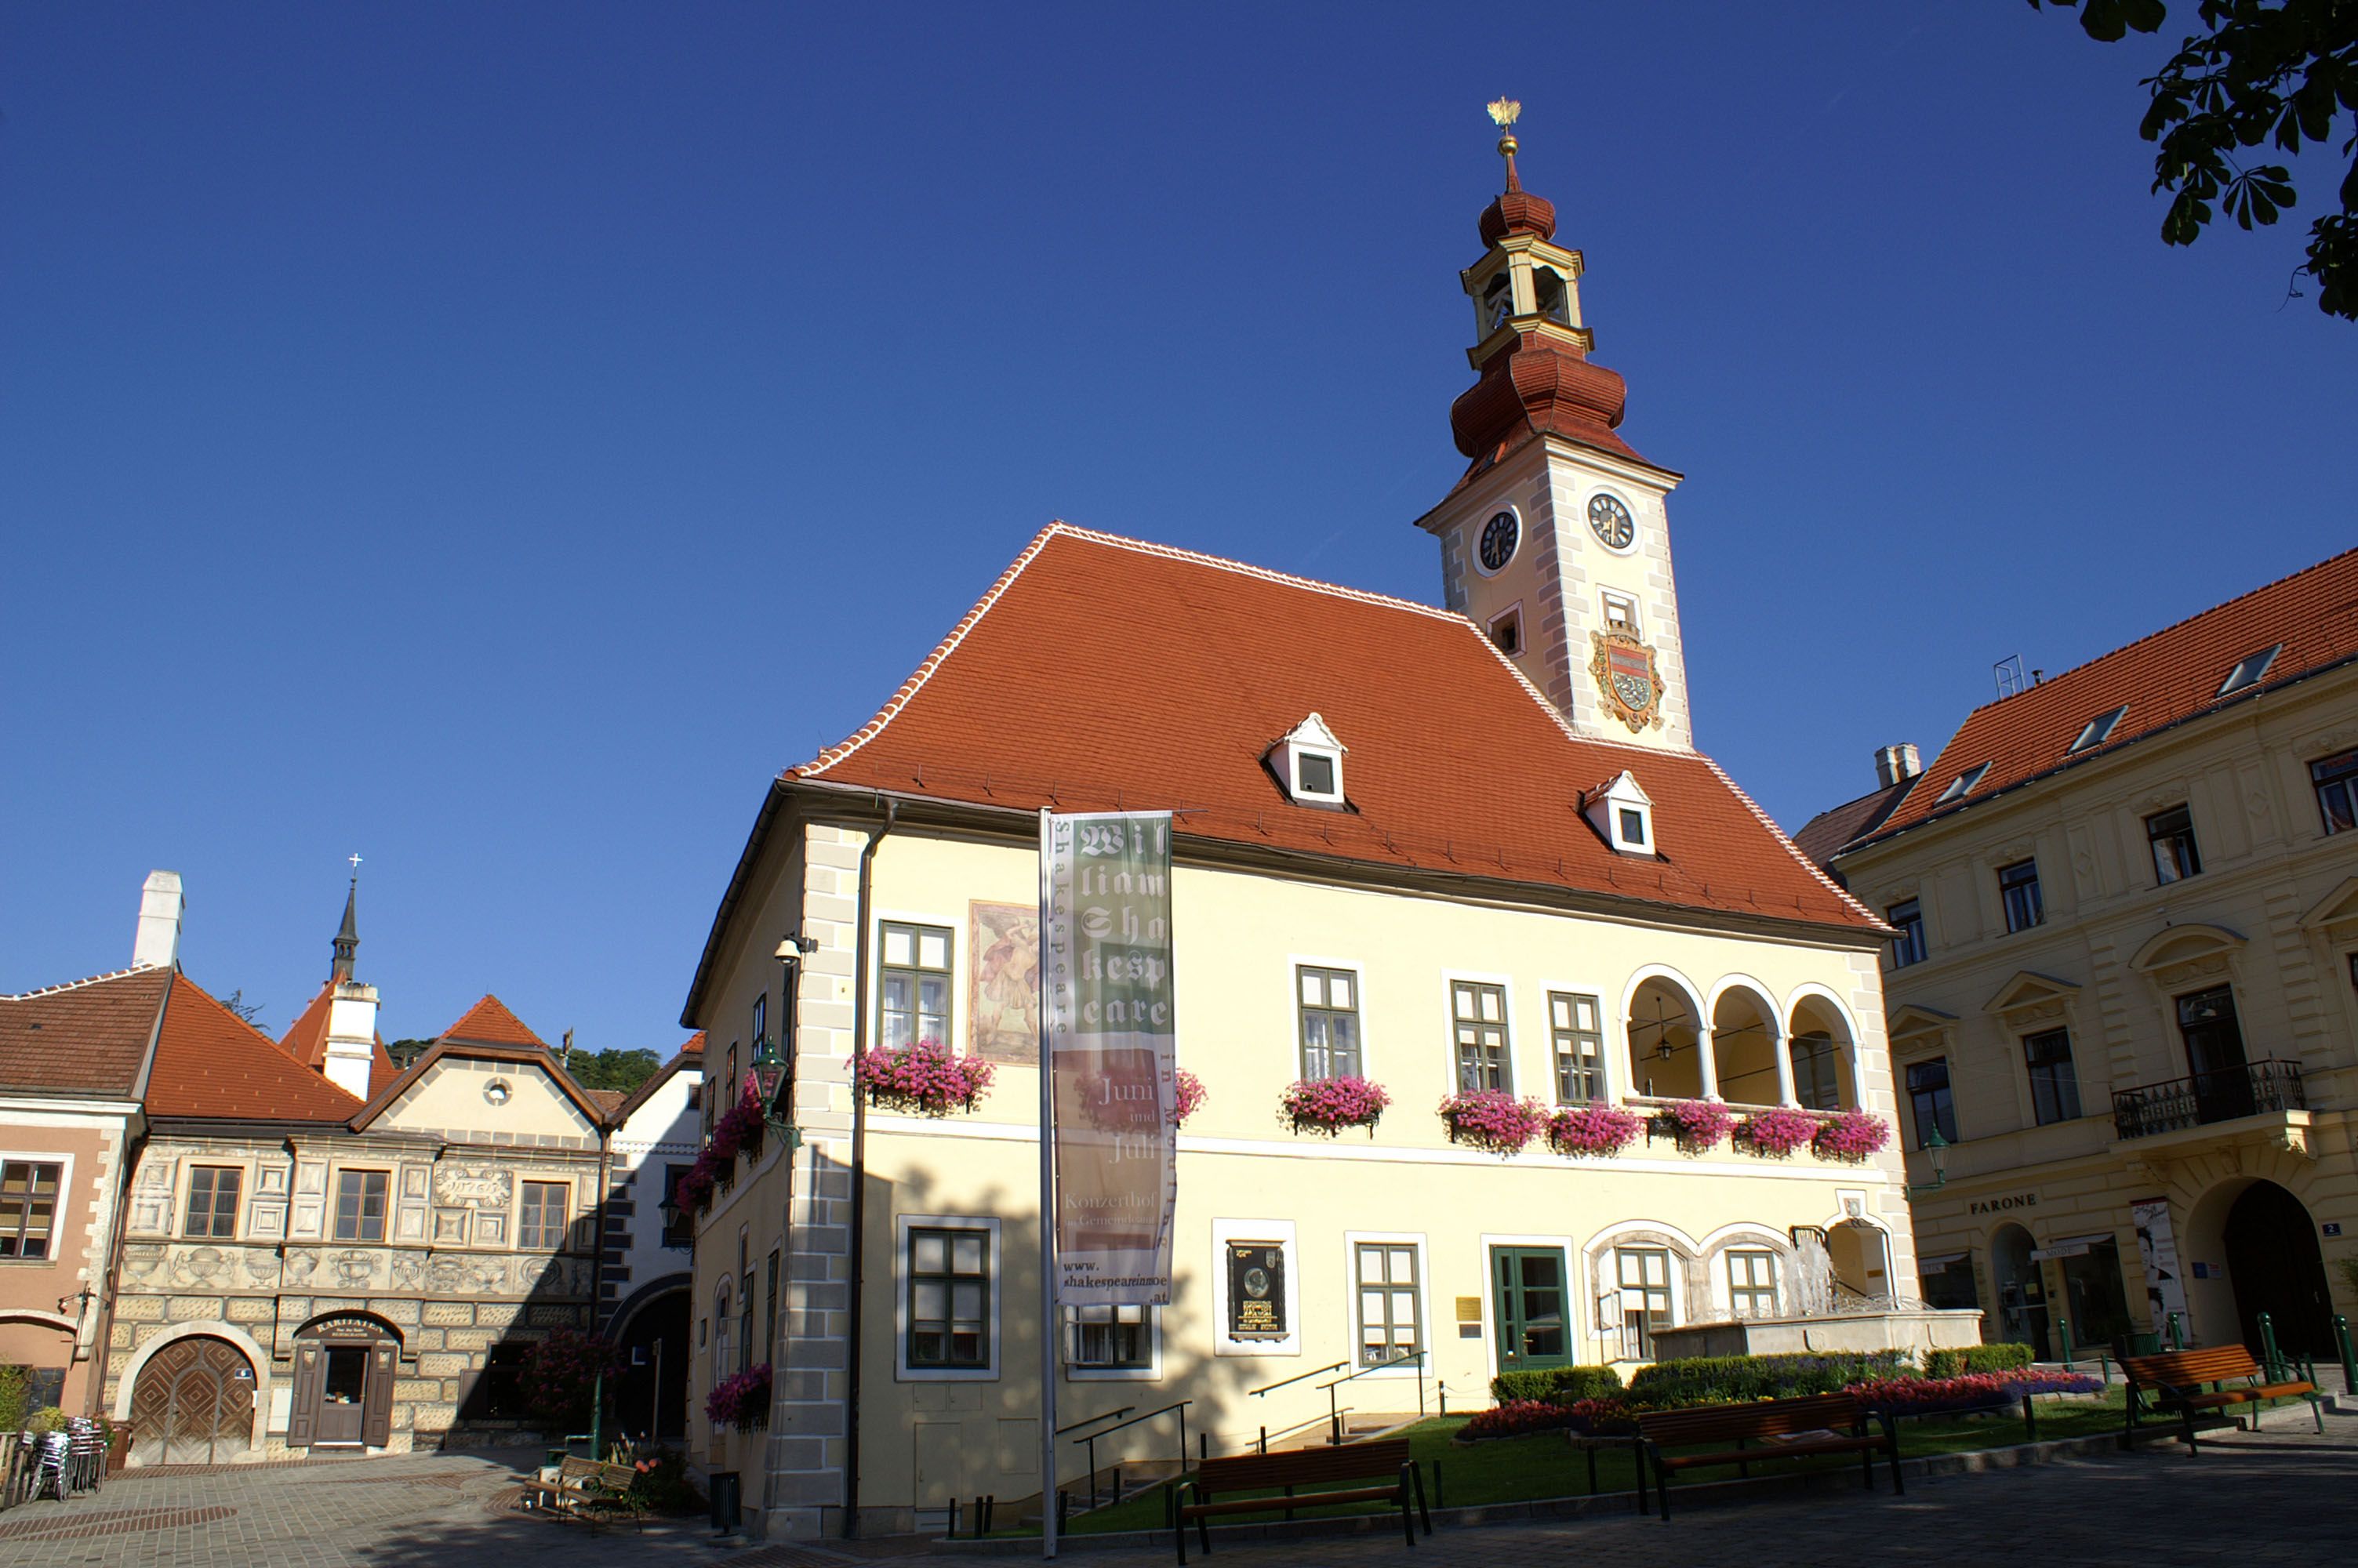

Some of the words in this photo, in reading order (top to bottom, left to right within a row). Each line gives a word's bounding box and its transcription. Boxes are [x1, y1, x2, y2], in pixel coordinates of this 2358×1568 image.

[1080, 823, 1166, 857] Wil
[1081, 865, 1166, 898] liam
[1052, 822, 1070, 1034] Shakespeare
[1081, 906, 1165, 946] Sha
[1082, 949, 1166, 993] kesp
[1083, 999, 1168, 1026] eare
[1098, 1076, 1155, 1105] Juni
[1130, 1109, 1156, 1123] und
[1108, 1134, 1156, 1164] Juli
[1065, 1191, 1158, 1210] Konzerthof
[1969, 1193, 2037, 1215] FARONE
[2327, 1224, 2334, 1232] 2
[1063, 1261, 1099, 1272] www.
[1150, 1292, 1168, 1304] .at
